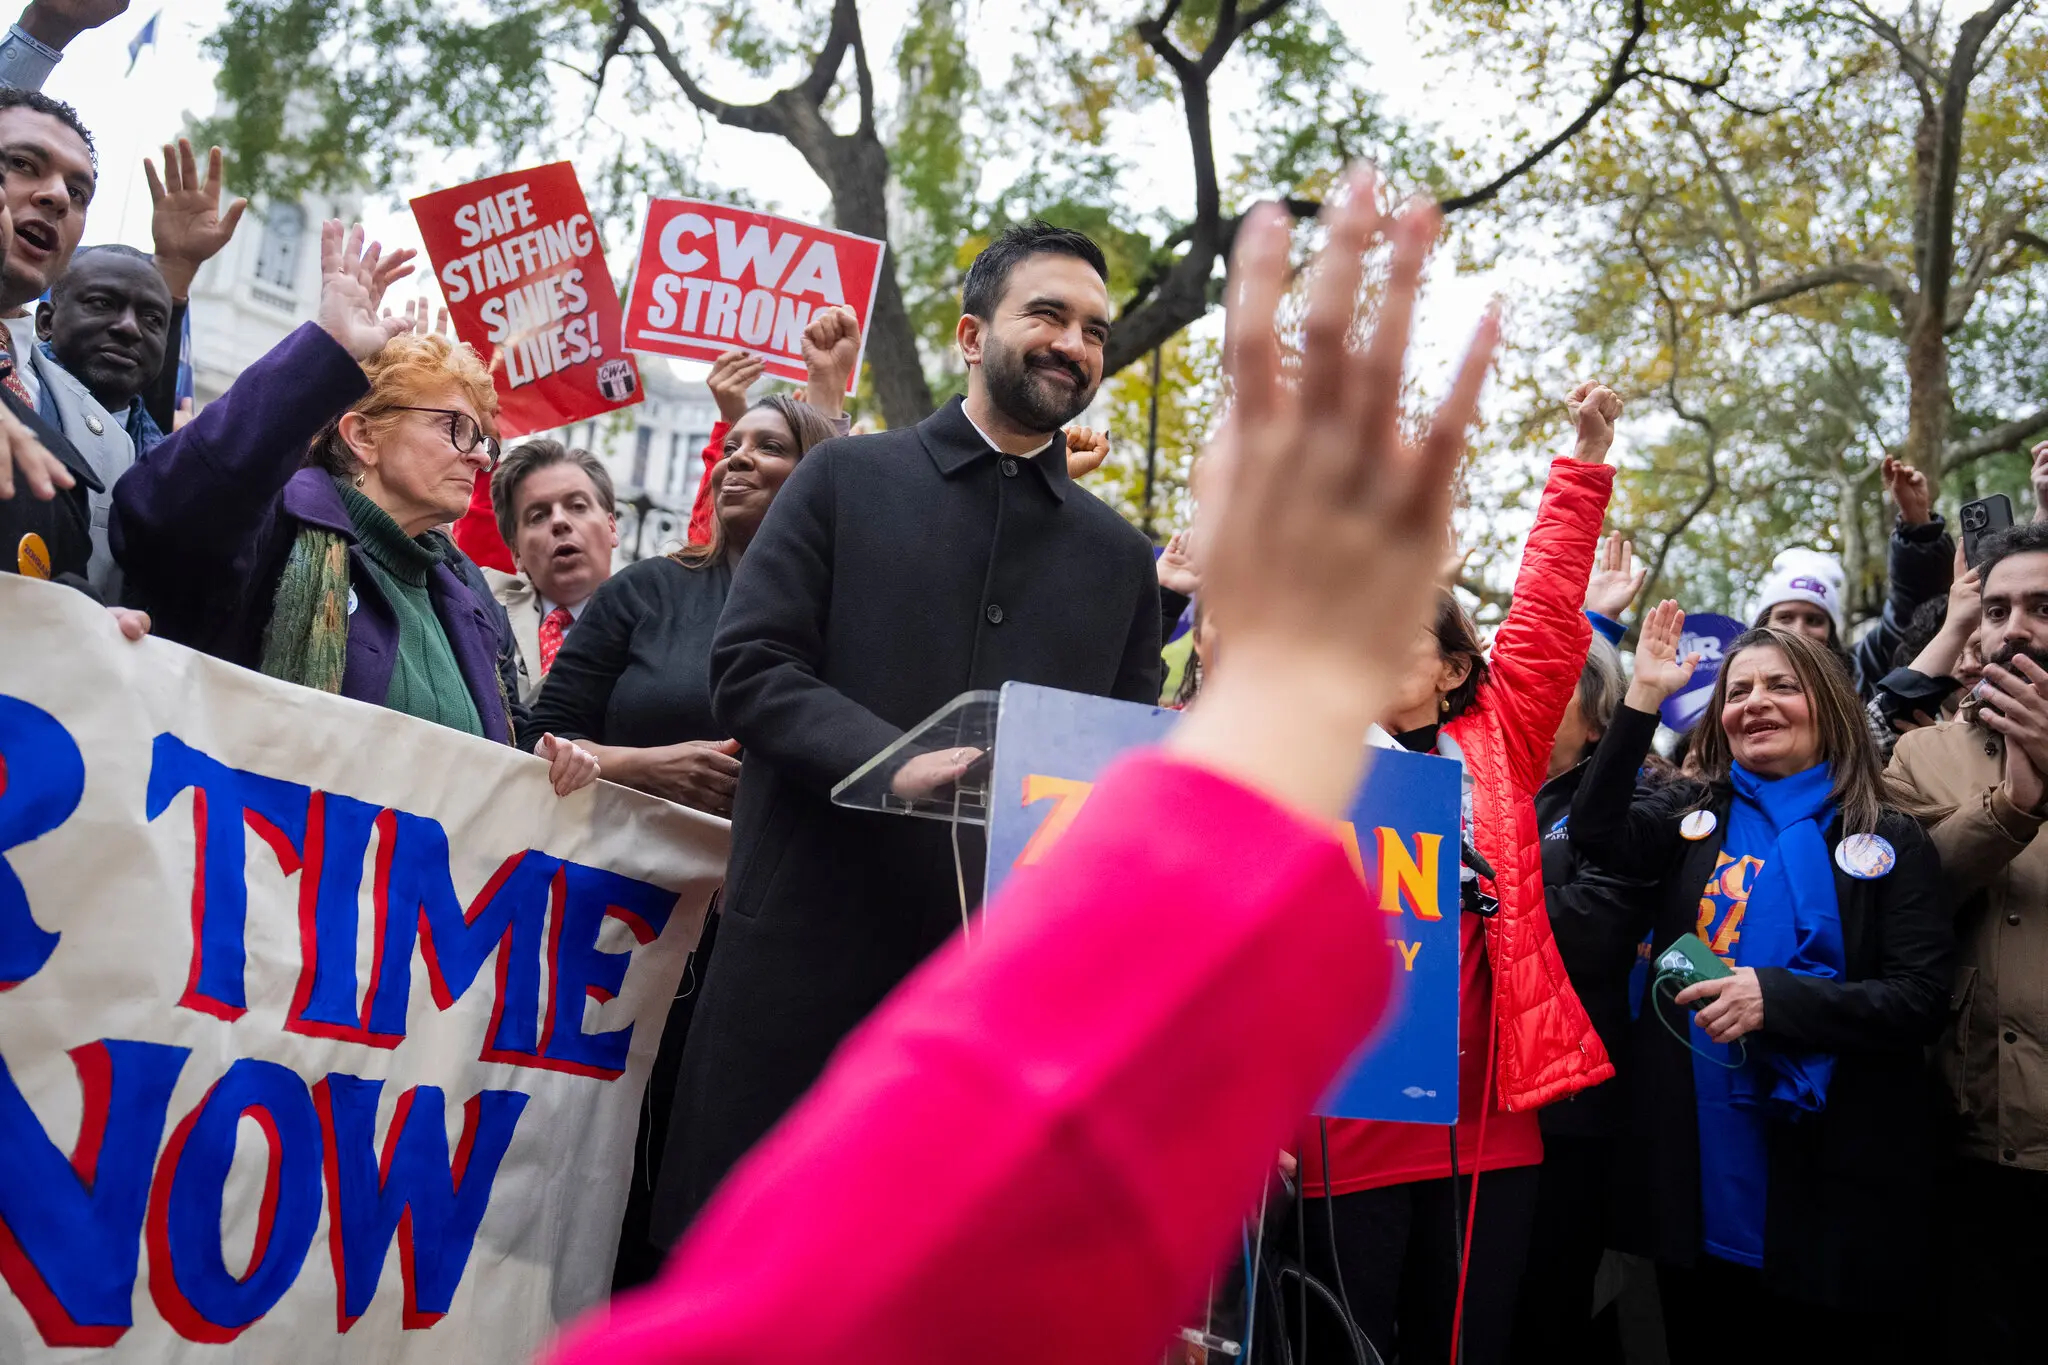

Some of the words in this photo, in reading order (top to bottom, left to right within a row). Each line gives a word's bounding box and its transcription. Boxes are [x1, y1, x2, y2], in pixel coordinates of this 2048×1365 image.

[454, 183, 537, 248] SAFE
[442, 213, 593, 302] STAFFING
[659, 213, 845, 305] CWA
[480, 268, 588, 345] SAVES
[647, 273, 832, 355] STRON
[504, 311, 603, 390] LIVES!
[601, 362, 627, 380] CWA
[146, 731, 682, 1081] TIME
